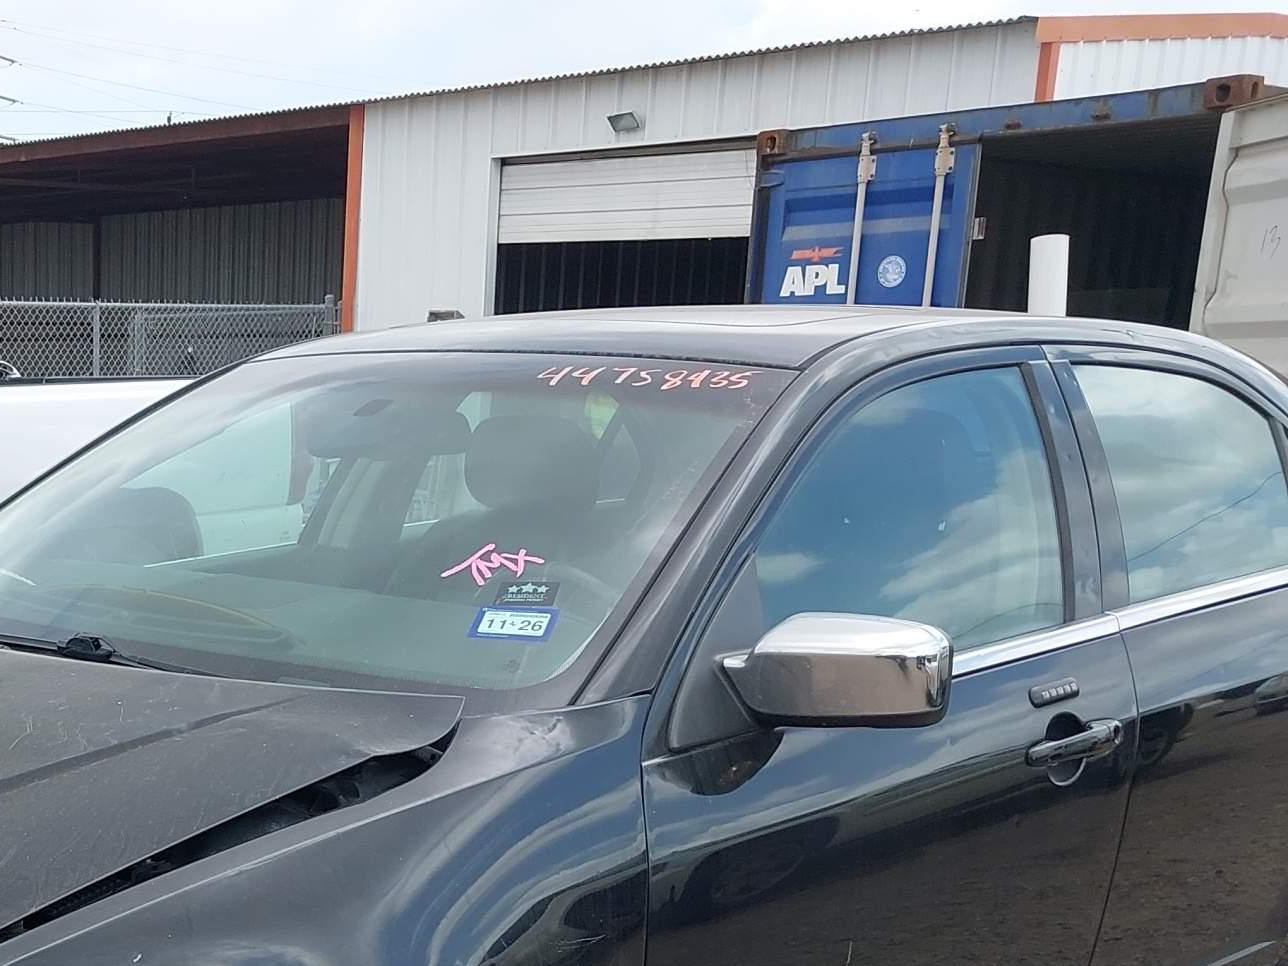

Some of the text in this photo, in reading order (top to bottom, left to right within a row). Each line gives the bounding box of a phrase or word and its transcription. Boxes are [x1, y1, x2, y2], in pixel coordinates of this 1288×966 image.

[780, 262, 846, 297] APL
[487, 618, 545, 632] 11 26
